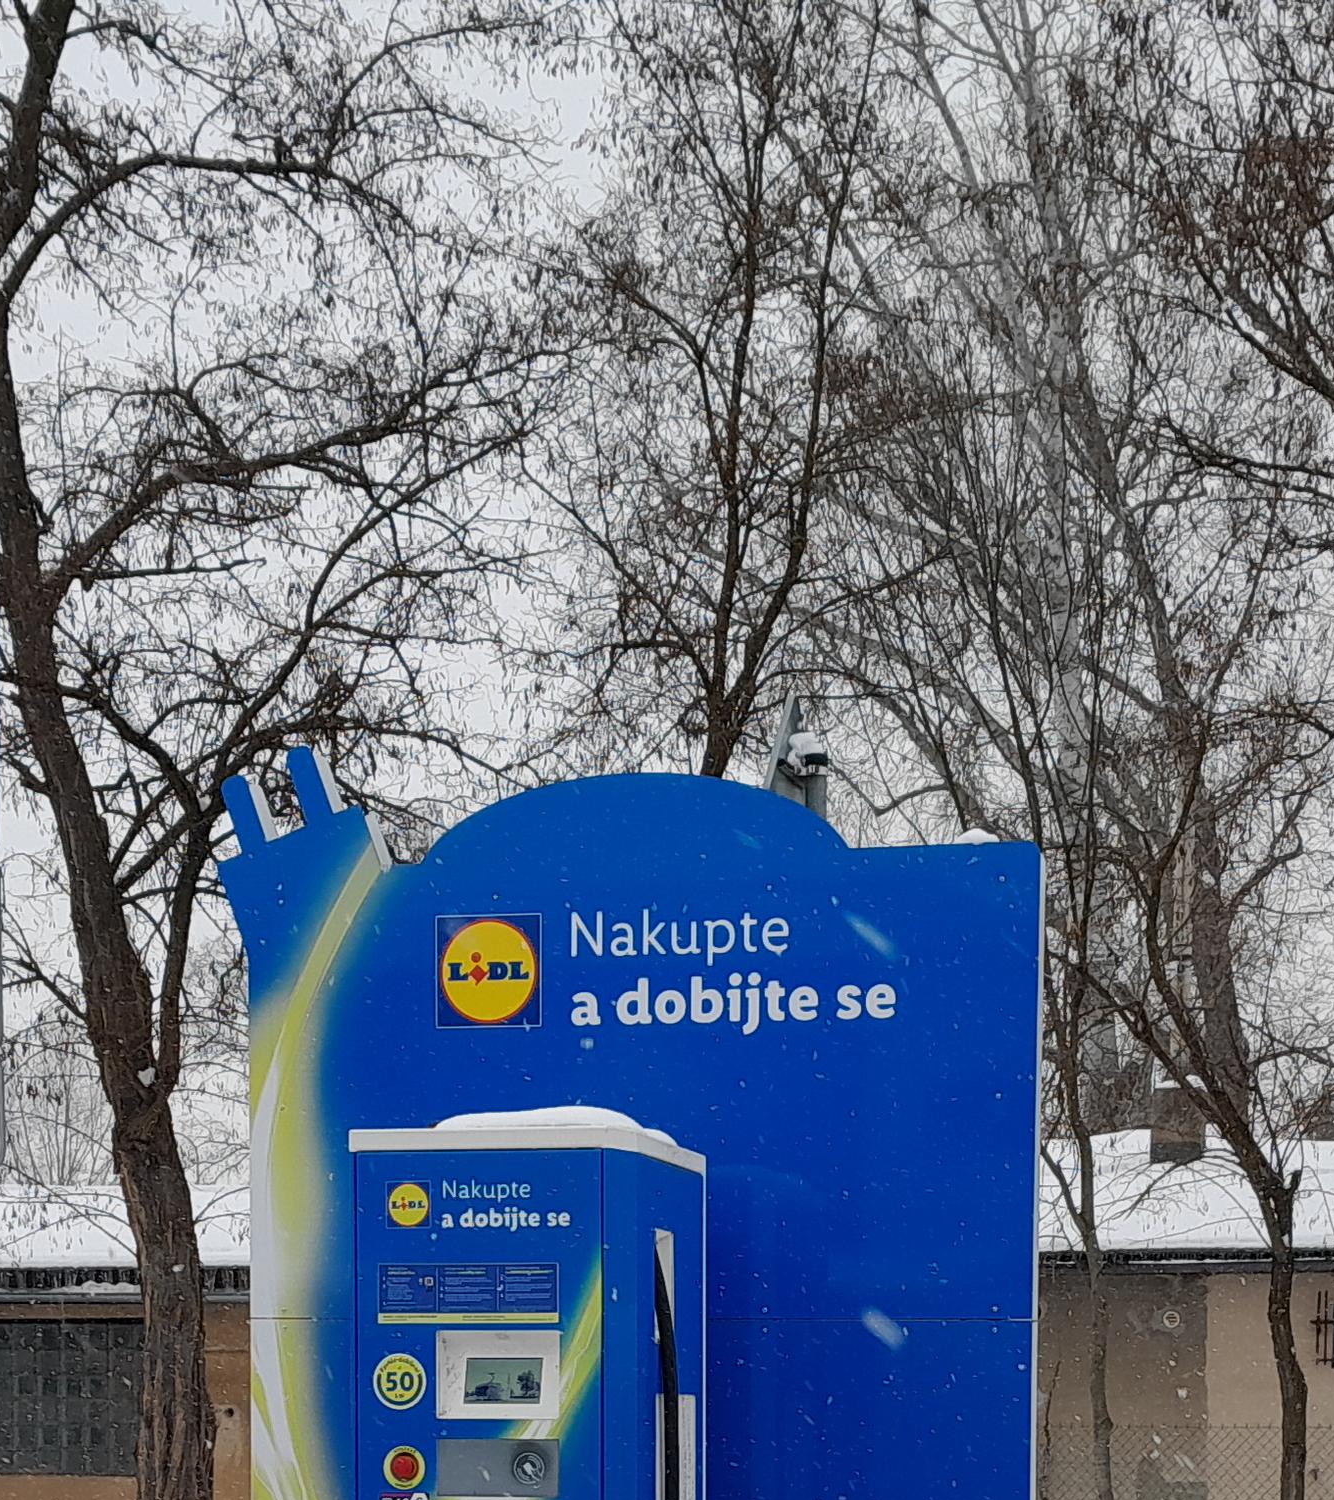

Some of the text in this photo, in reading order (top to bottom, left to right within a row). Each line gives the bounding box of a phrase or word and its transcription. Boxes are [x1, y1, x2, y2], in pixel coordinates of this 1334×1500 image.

[571, 908, 789, 966] Nakupte
[571, 972, 896, 1035] a dobijte se
[442, 1179, 531, 1202] Nakupte
[441, 1207, 571, 1231] a dobijte se
[386, 1371, 414, 1392] 50
